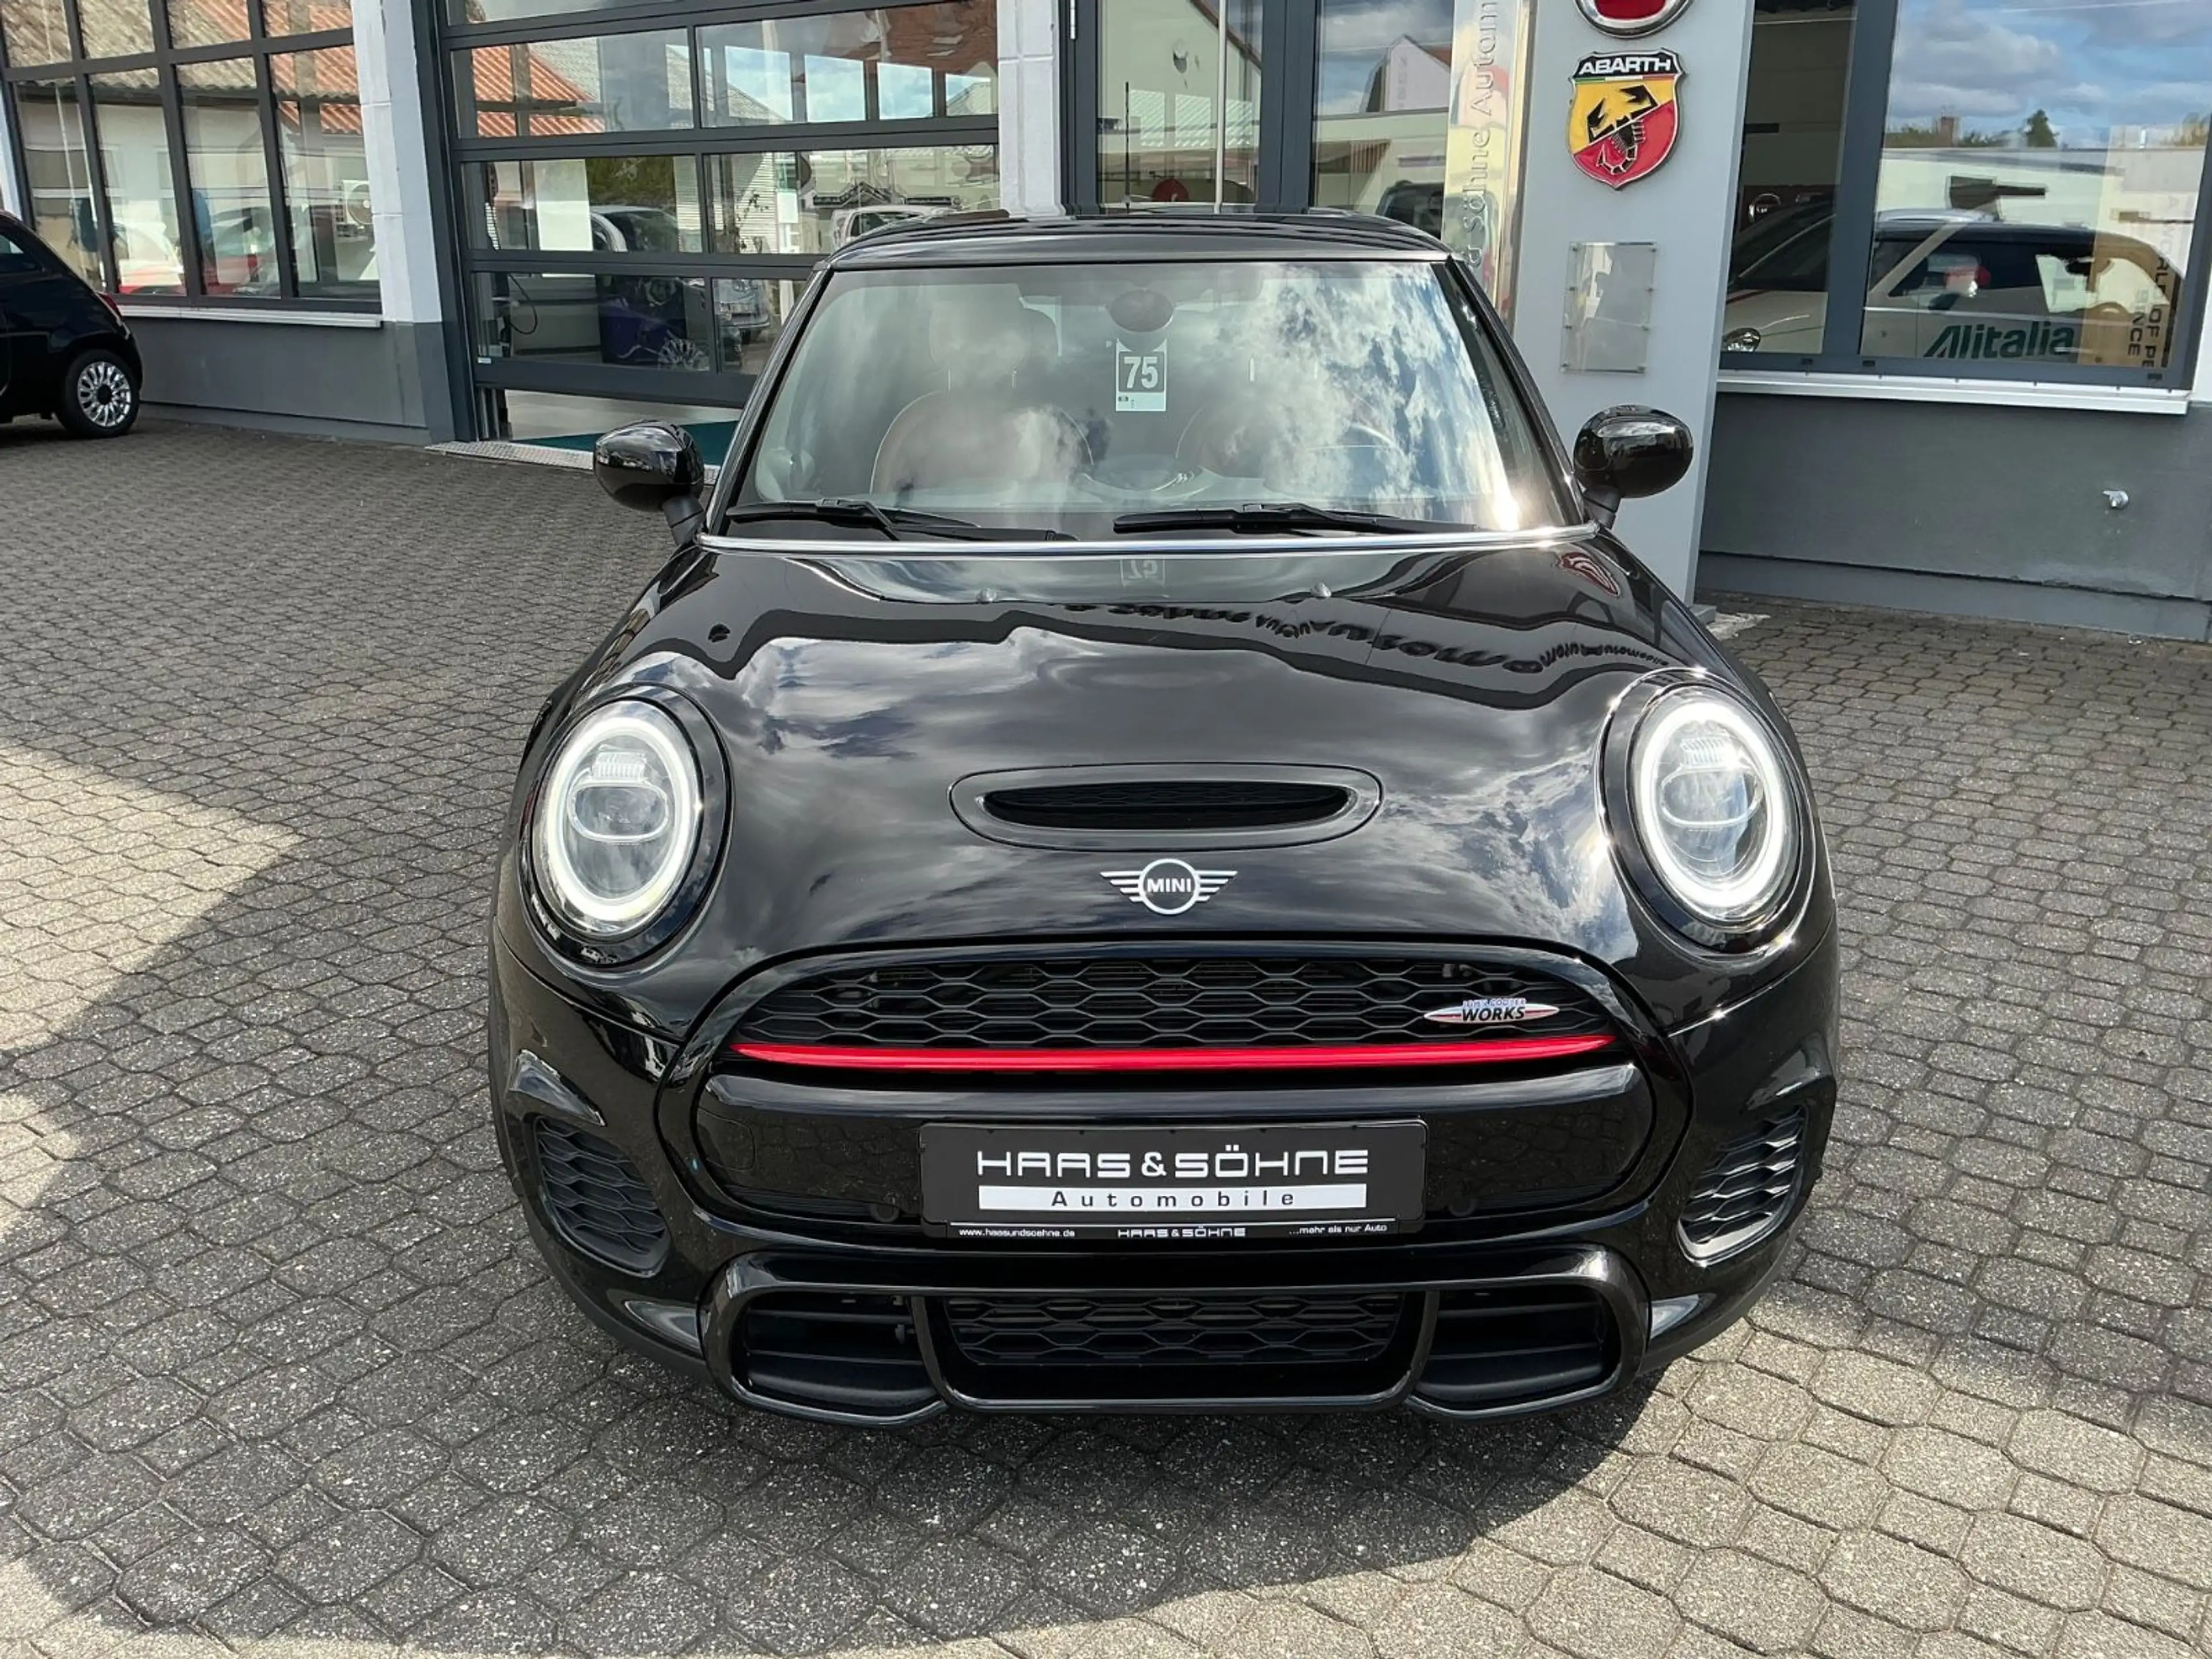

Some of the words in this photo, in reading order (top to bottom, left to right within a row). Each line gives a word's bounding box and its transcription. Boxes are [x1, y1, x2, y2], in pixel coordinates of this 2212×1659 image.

[1578, 57, 1671, 75] ABARTH
[1462, 129, 1491, 233] Söhne
[2147, 308, 2162, 339] OF
[1923, 320, 2074, 359] Alitalia
[1124, 356, 1158, 389] 75
[1146, 877, 1192, 893] MINI
[1462, 1006, 1525, 1021] WORKS
[978, 1151, 1130, 1178] HAAS
[1141, 1152, 1166, 1177] &
[1175, 1144, 1369, 1178] SÖHNE
[1051, 1190, 1294, 1207] Automobile
[959, 1228, 1075, 1237] www.haasundsoehne.de
[1345, 1224, 1362, 1233] nur
[1363, 1224, 1388, 1232] Auto
